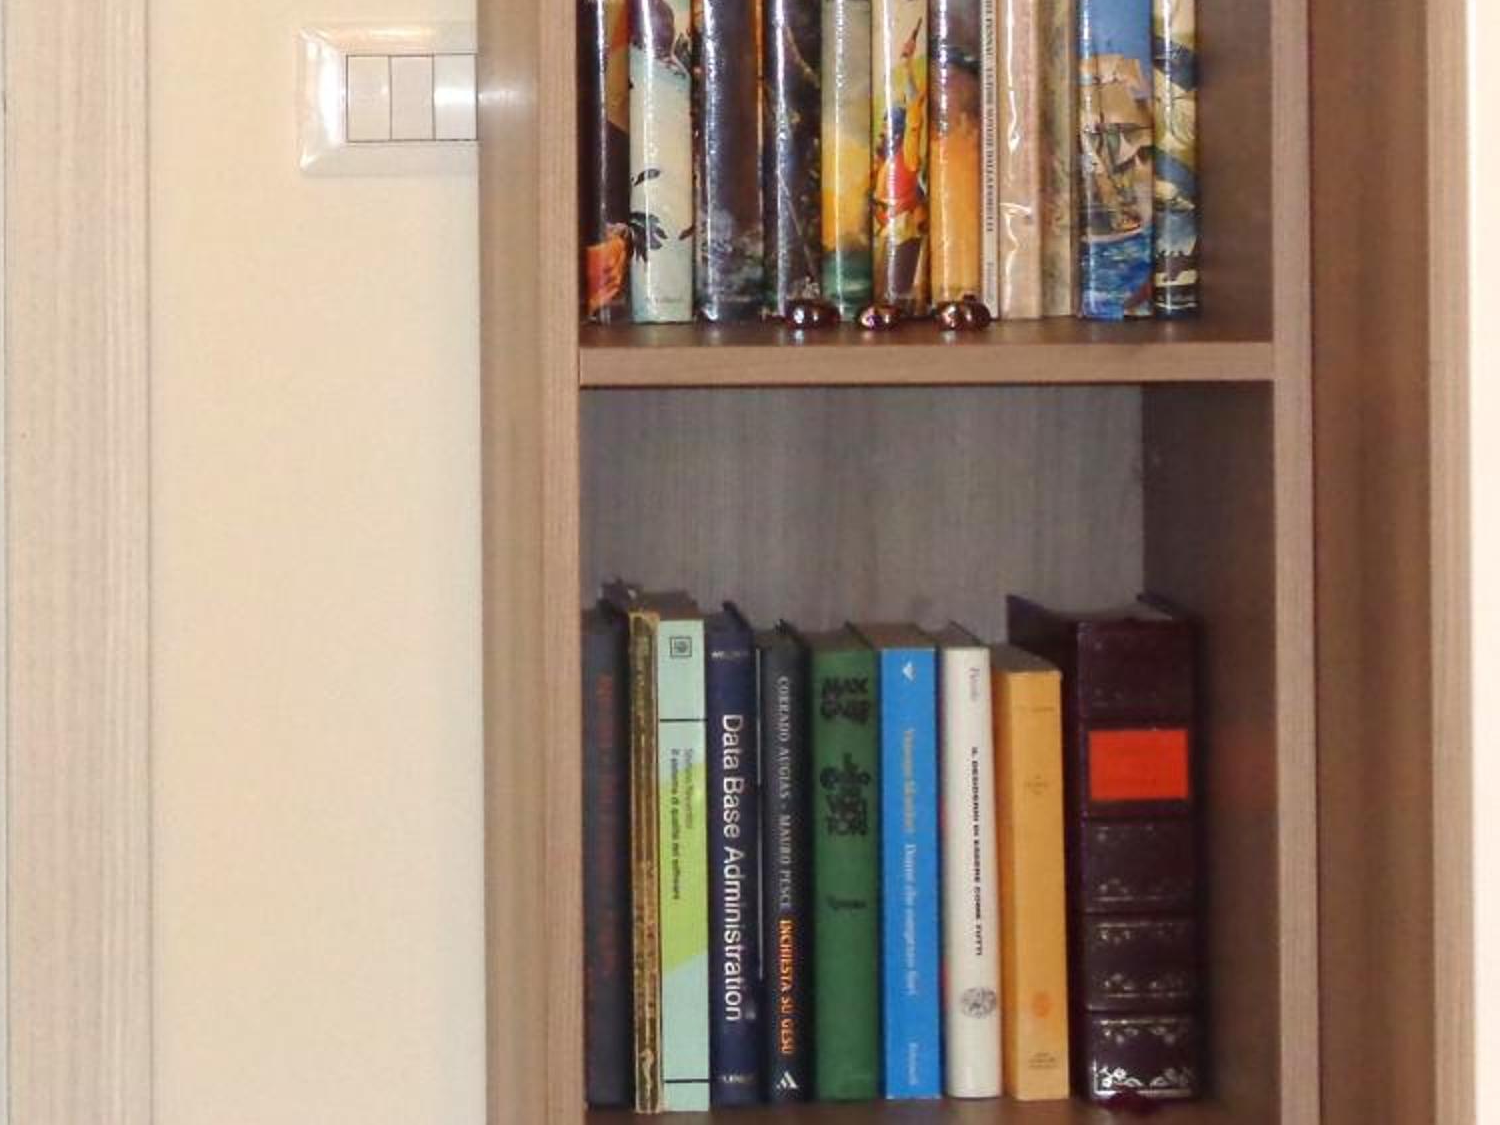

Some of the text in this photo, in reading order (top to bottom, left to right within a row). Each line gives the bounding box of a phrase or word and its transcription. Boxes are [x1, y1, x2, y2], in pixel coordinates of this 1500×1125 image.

[777, 676, 791, 742] CORRADO
[778, 746, 791, 799] AUGIAS
[723, 714, 746, 1021] Data Base Administration
[778, 814, 792, 865] MAURO
[779, 919, 794, 992] INCHIESTA
[780, 996, 794, 1014] SU
